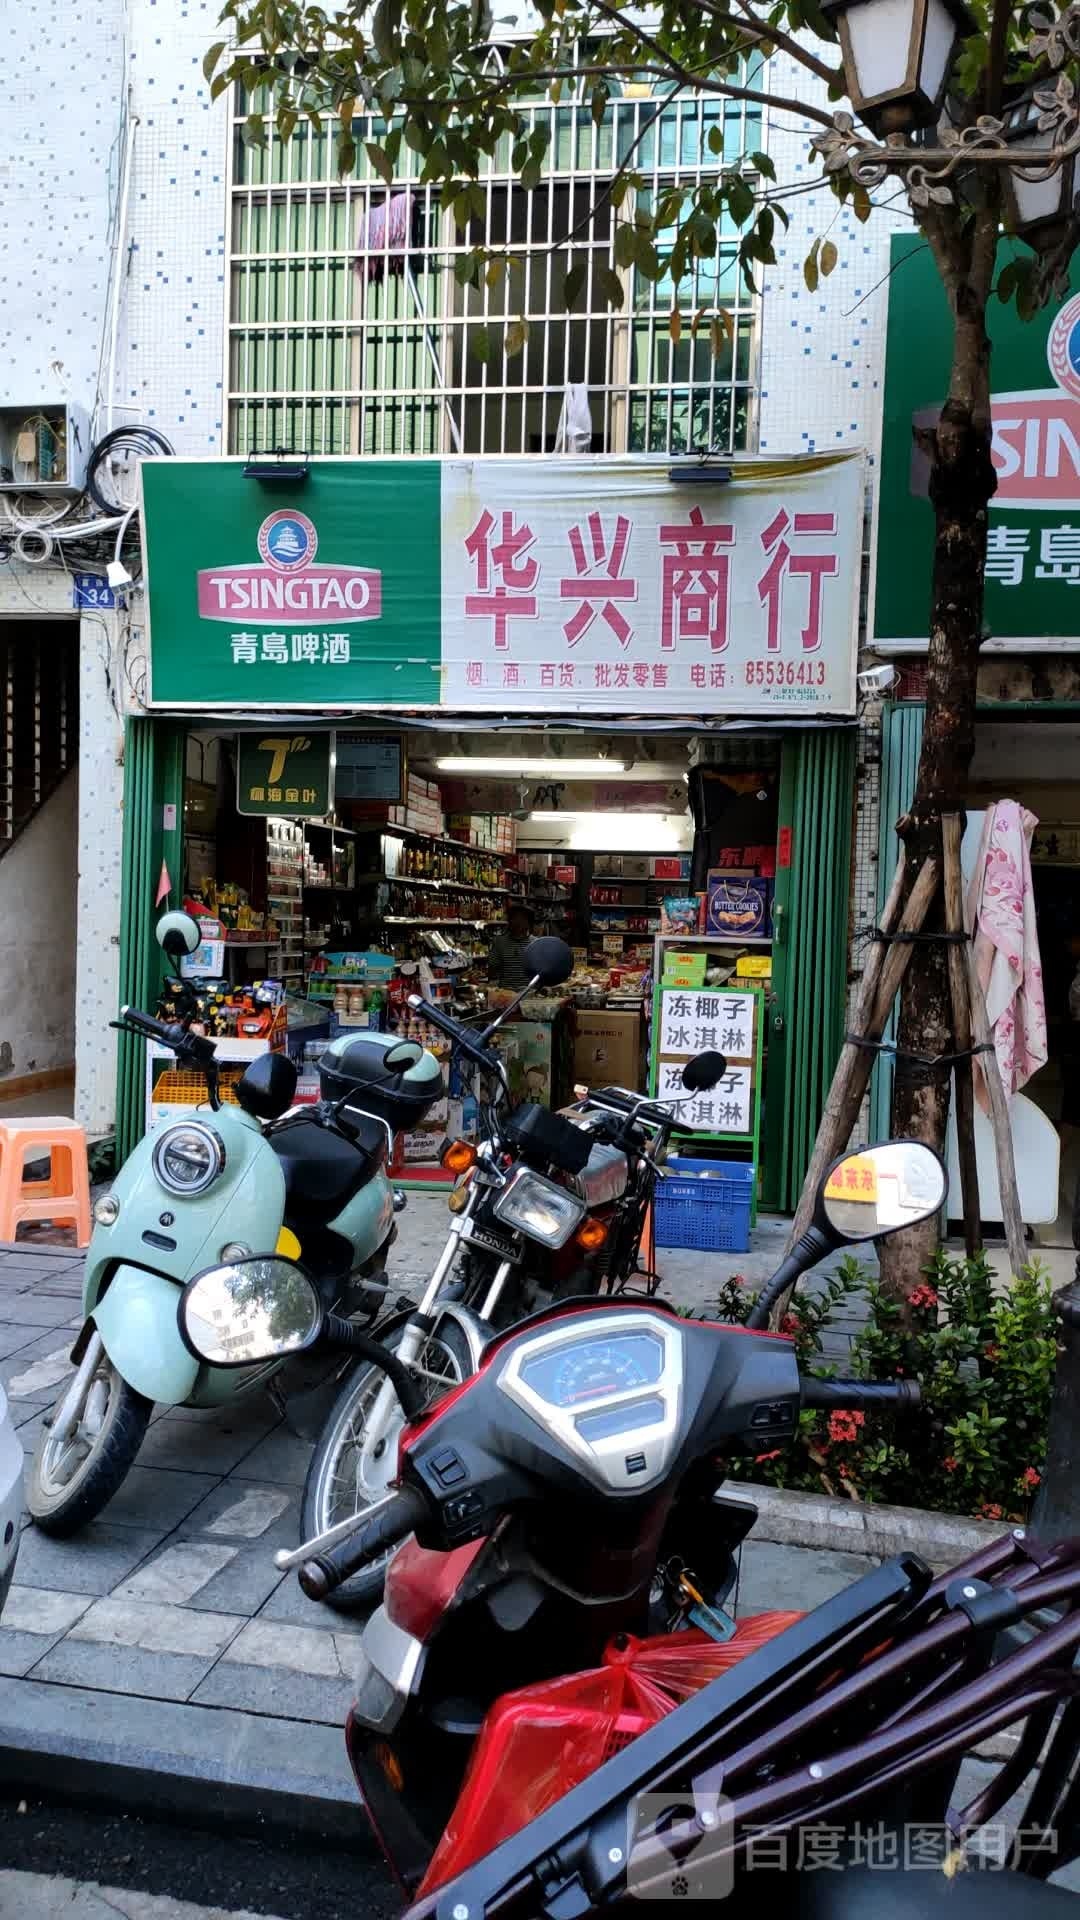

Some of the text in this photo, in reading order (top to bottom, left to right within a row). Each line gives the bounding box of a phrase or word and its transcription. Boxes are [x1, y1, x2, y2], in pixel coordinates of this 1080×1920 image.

[464, 505, 840, 653] 华兴商行
[88, 588, 110, 604] 34
[209, 577, 370, 610] TSINGTAO
[230, 632, 350, 664] 青島啤酒
[668, 995, 747, 1020] 冻椰子
[666, 1026, 746, 1051] 冰淇淋
[665, 1068, 744, 1093] 冻子
[473, 1230, 518, 1257] HONDA
